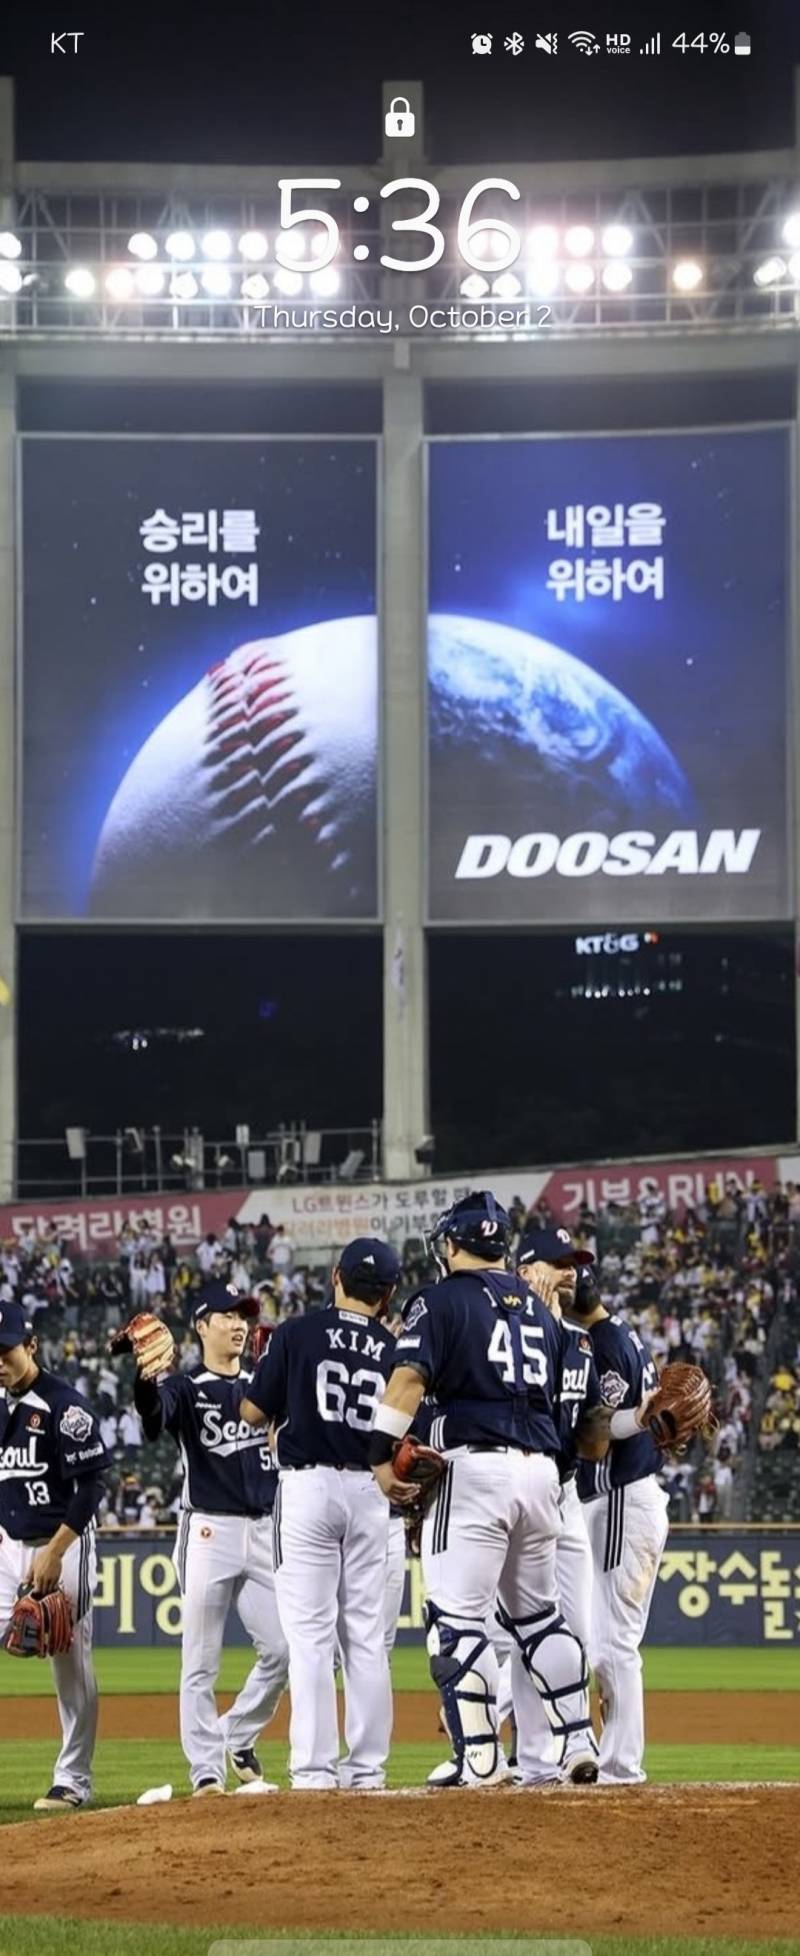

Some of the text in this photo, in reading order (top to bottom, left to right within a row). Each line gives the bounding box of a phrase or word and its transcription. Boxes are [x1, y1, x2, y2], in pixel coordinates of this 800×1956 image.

[139, 509, 260, 553] 승리를
[545, 502, 666, 548] 내일을
[141, 563, 259, 606] 위하여
[545, 556, 664, 601] 위하여
[454, 829, 761, 879] DOOSAN
[575, 932, 640, 955] KT&G
[292, 1191, 388, 1214] LG트윈스가
[325, 1328, 386, 1361] KIM
[487, 1318, 548, 1387] 45
[316, 1359, 387, 1433] 63
[0, 1436, 49, 1470] oul
[24, 1481, 51, 1506] 13
[658, 1551, 800, 1639] 장수돌
